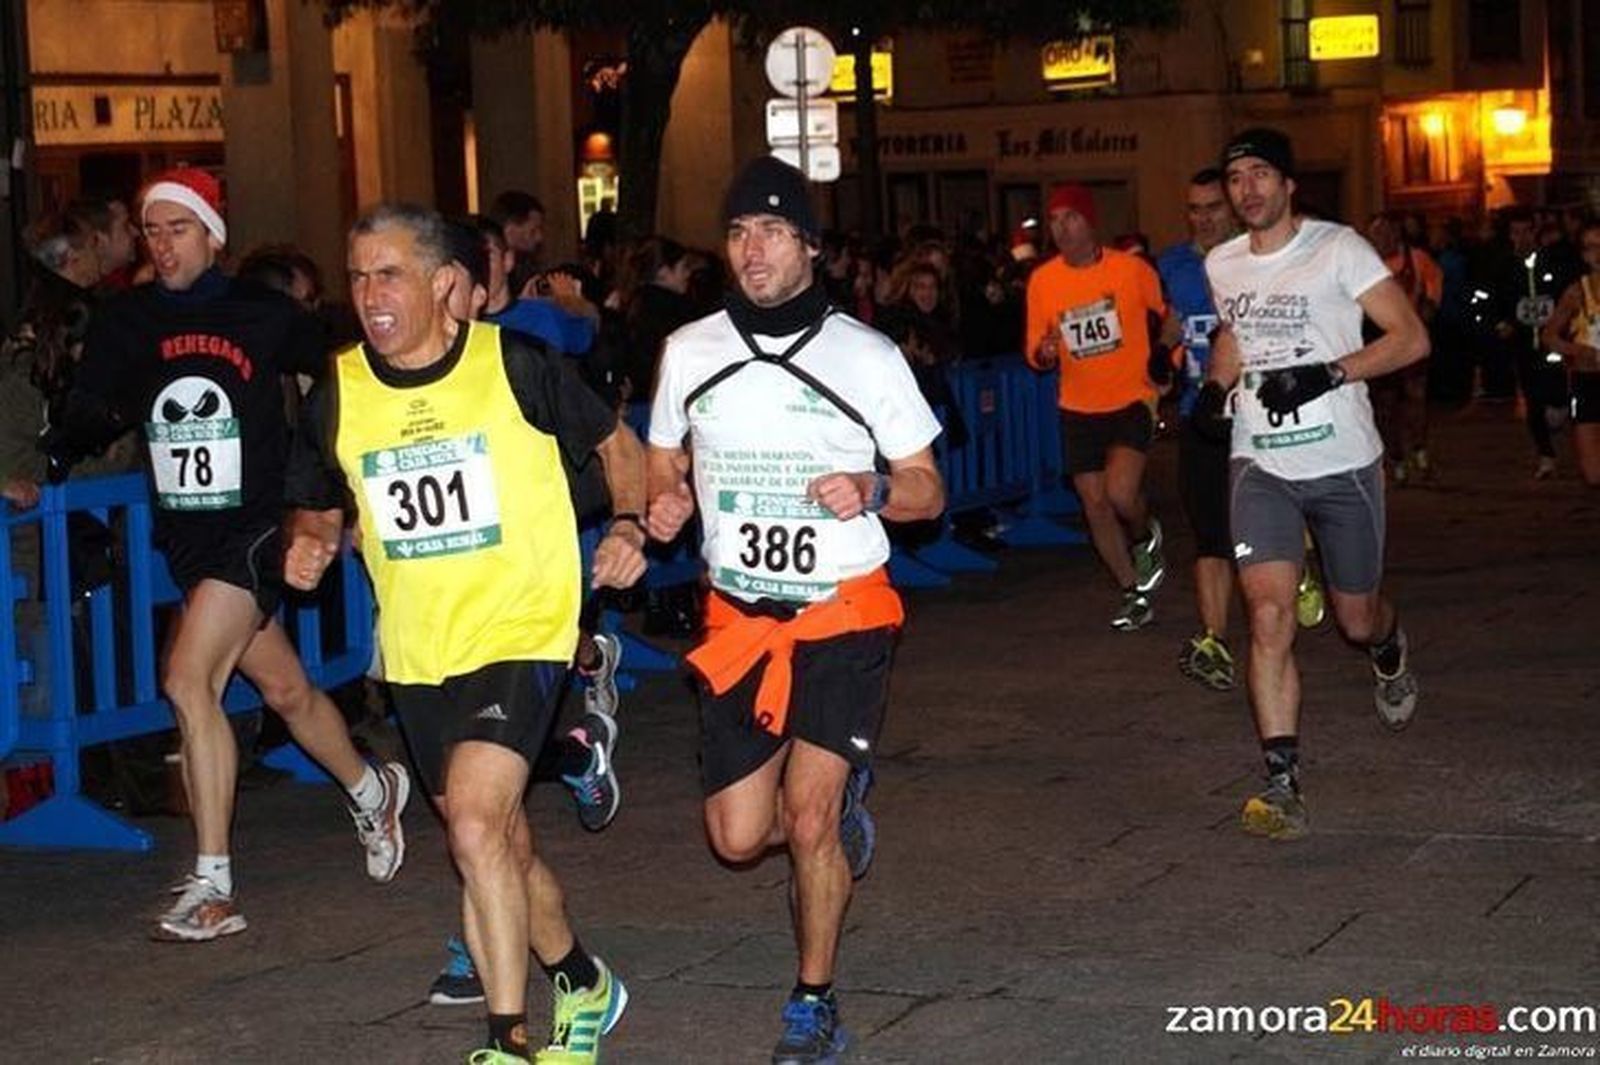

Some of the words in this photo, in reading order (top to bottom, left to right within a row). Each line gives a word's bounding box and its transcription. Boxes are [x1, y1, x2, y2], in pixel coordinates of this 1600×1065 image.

[134, 95, 225, 131] PLAZA
[1069, 317, 1111, 347] 746
[170, 446, 213, 488] 78
[387, 470, 470, 532] 301
[738, 522, 817, 575] 386
